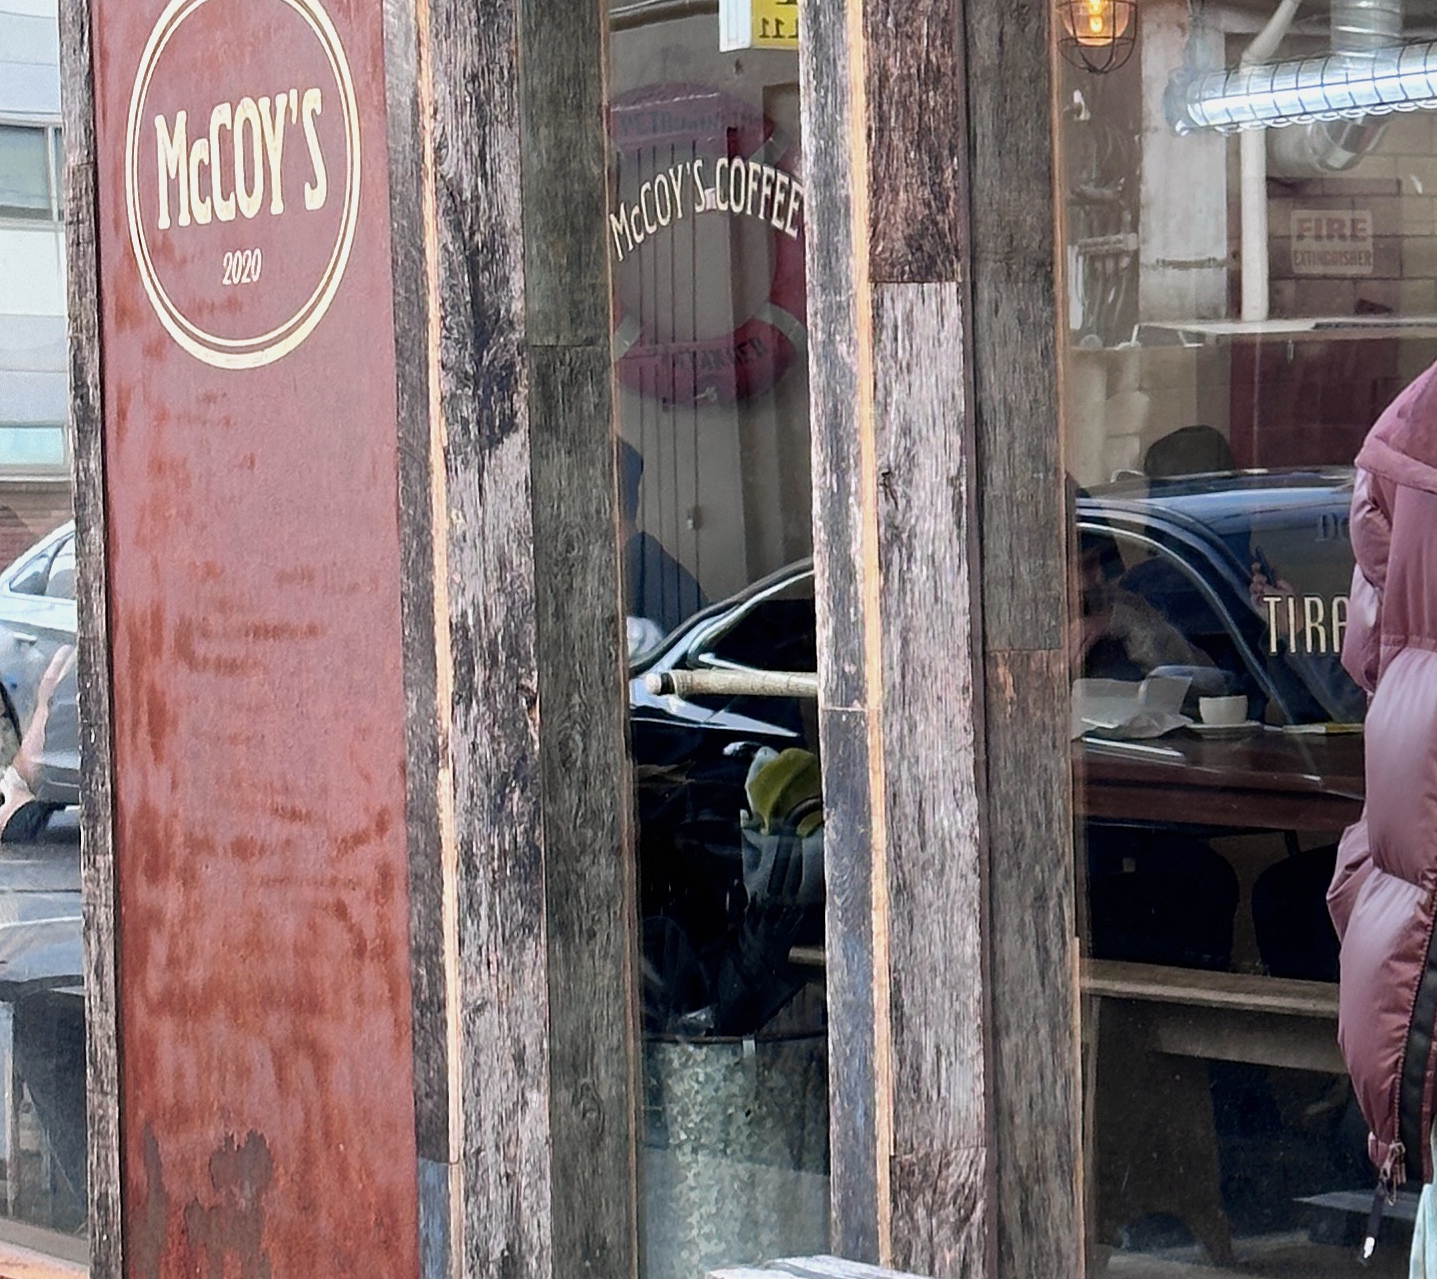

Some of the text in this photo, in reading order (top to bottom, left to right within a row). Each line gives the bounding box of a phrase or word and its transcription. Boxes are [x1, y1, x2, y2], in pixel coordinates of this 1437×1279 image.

[154, 87, 328, 230] McCOY'S
[609, 155, 805, 263] McCOY'S COFFEE
[1296, 217, 1368, 242] FIRE
[221, 247, 263, 286] 2020
